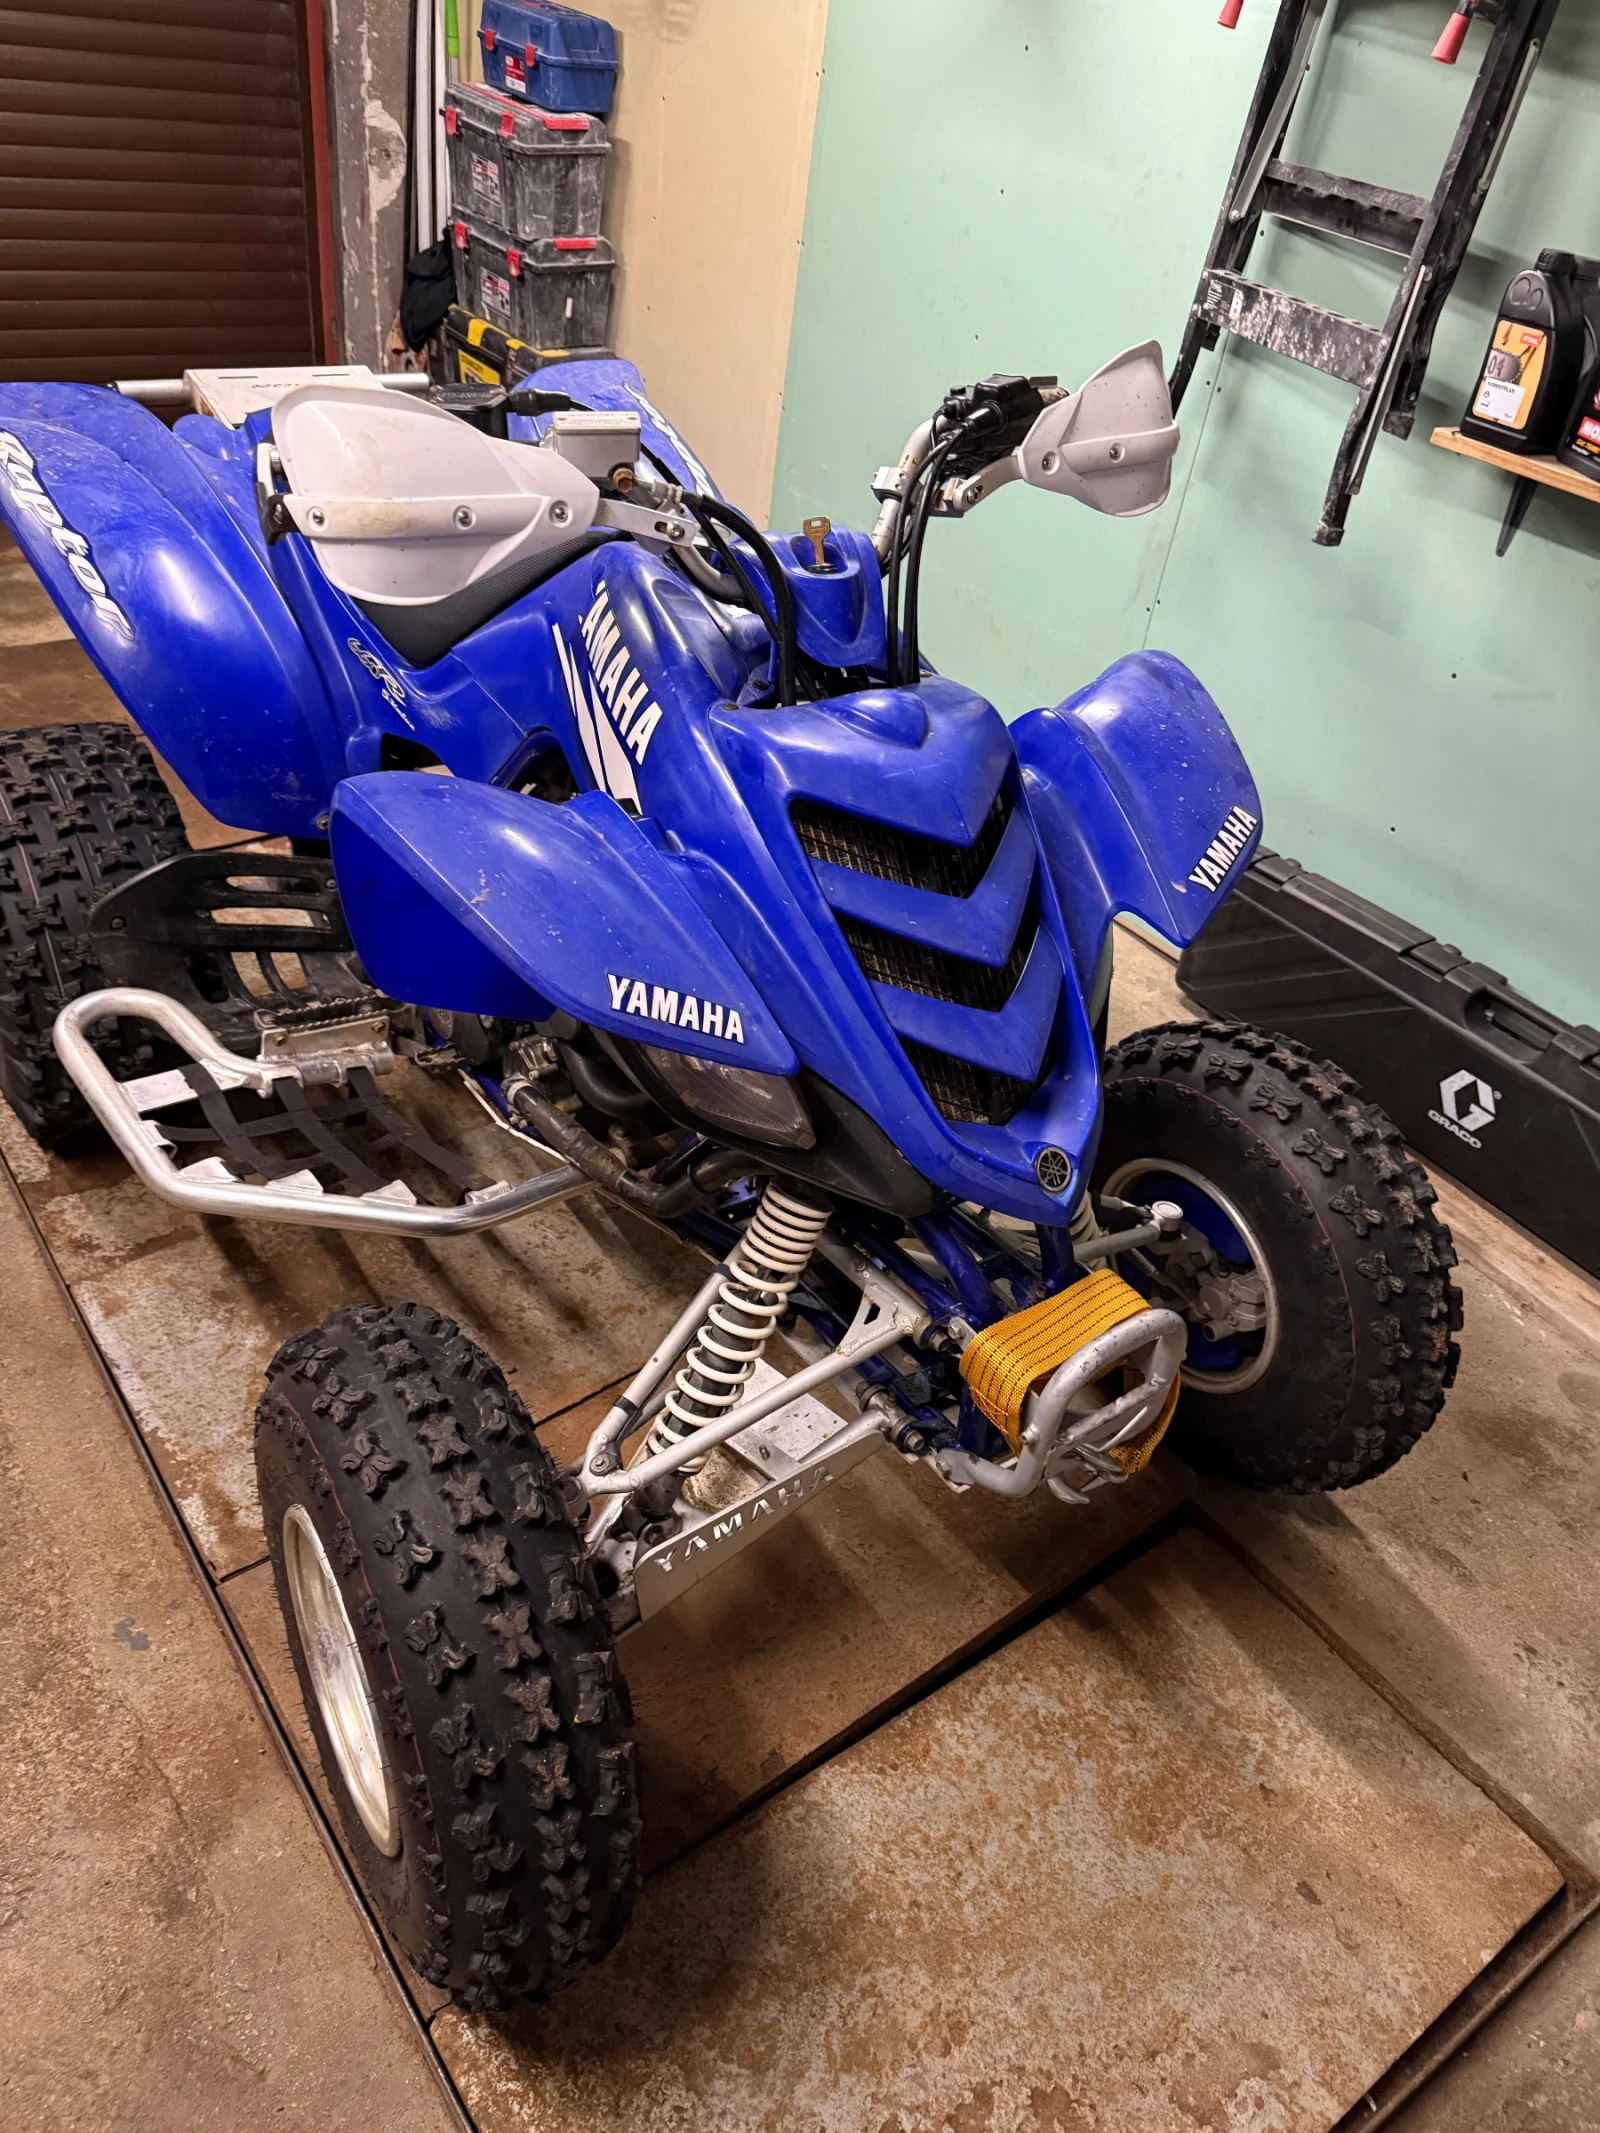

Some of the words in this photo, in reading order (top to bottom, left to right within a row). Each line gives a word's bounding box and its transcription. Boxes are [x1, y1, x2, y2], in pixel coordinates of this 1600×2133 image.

[1581, 420, 1600, 443] MO
[578, 580, 662, 765] AMAHA
[1188, 806, 1257, 892] YAMAHA
[607, 974, 744, 1044] YAMAHA
[1428, 1109, 1482, 1149] GRACO
[654, 1466, 834, 1572] YAMAHA
